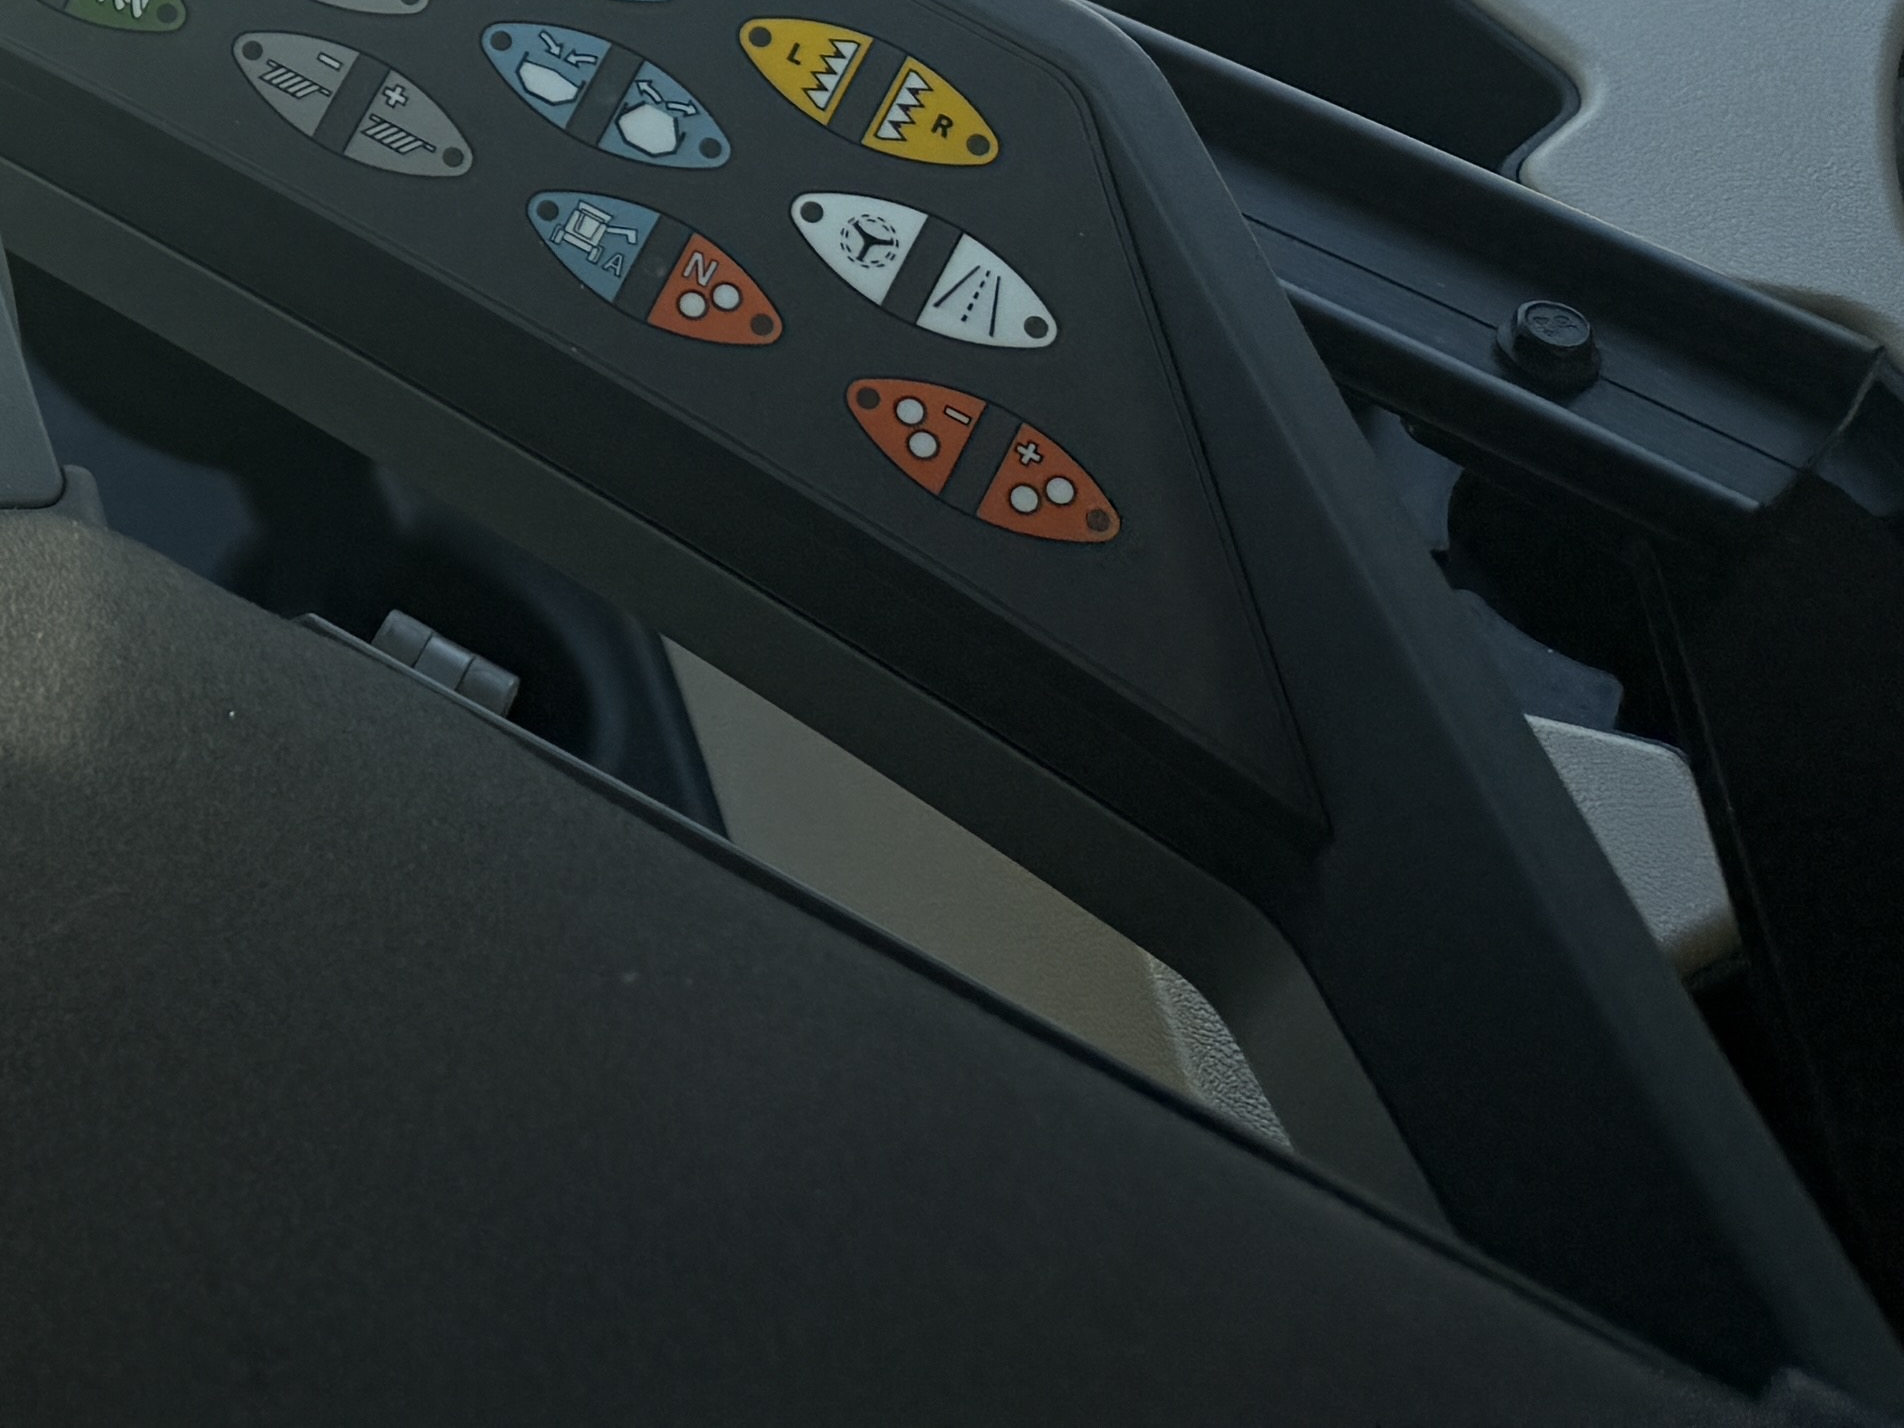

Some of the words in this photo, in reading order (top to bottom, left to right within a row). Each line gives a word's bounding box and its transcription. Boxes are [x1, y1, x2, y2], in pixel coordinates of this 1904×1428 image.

[786, 42, 802, 66] L
[931, 113, 954, 139] R
[602, 253, 624, 278] A
[682, 250, 719, 287] N
